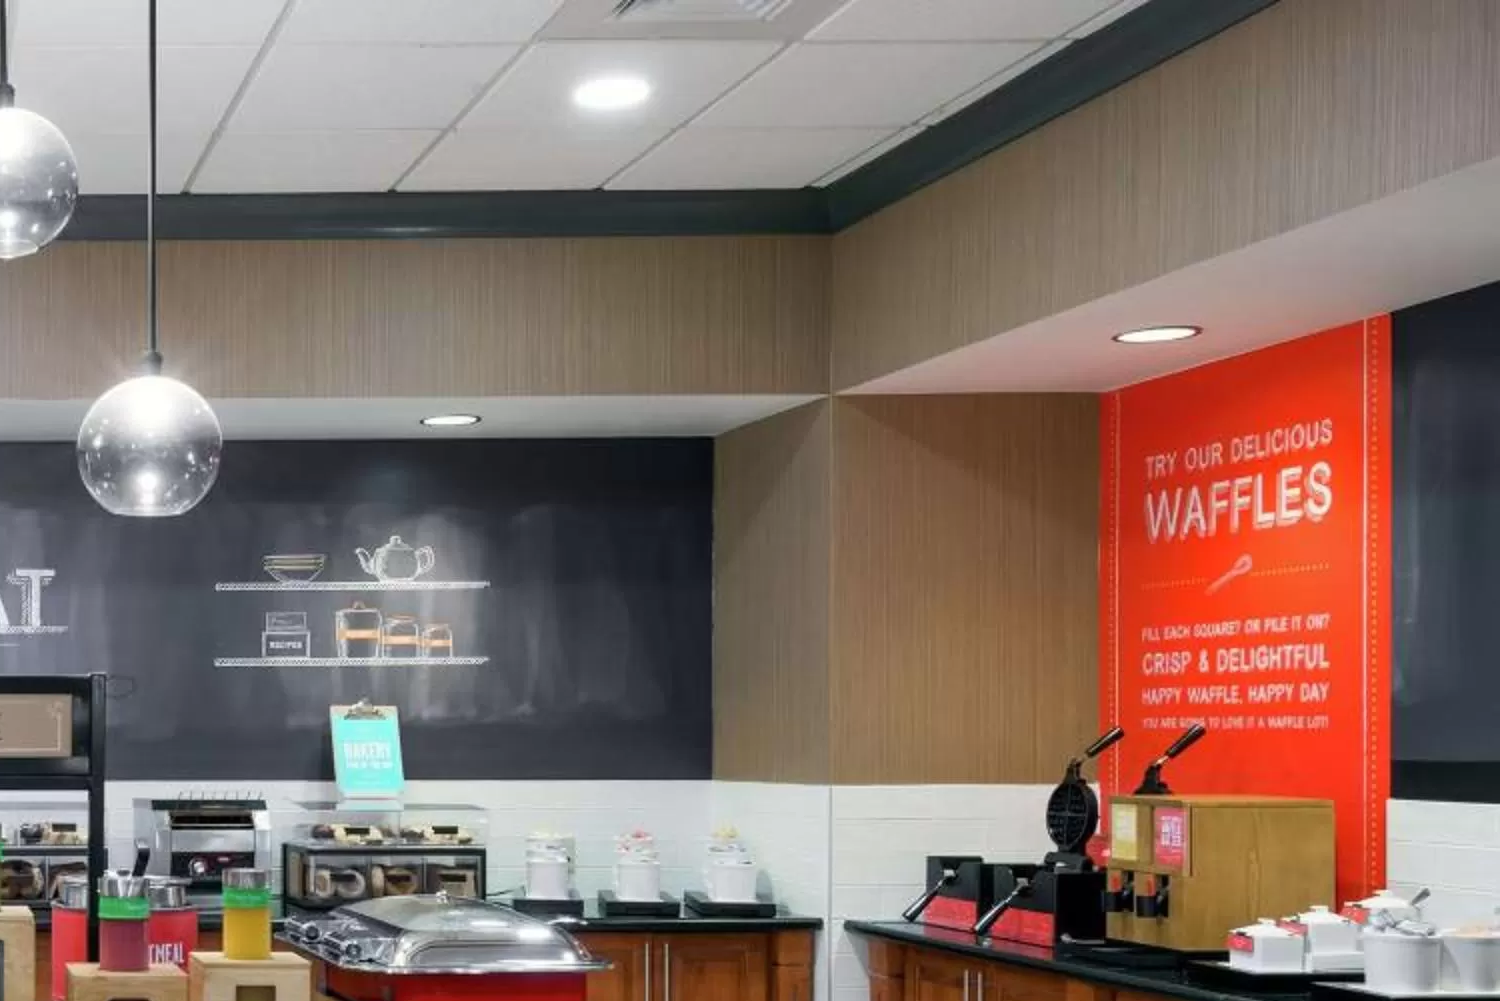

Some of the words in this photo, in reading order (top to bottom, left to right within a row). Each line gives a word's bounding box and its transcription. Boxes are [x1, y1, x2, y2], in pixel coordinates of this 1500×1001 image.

[1144, 453, 1177, 481] TRY
[1185, 442, 1223, 471] OUR
[1230, 417, 1332, 465] DELICIOUS
[1144, 461, 1333, 545] WAFFLES
[1142, 651, 1192, 677] CRISP
[1198, 648, 1210, 675] &
[1215, 643, 1331, 674] DELIGHTFUL
[1141, 686, 1181, 706] HAPPY
[1248, 682, 1294, 704] HAPPY
[1300, 681, 1330, 703] DAY
[149, 940, 185, 968] TMEAL
